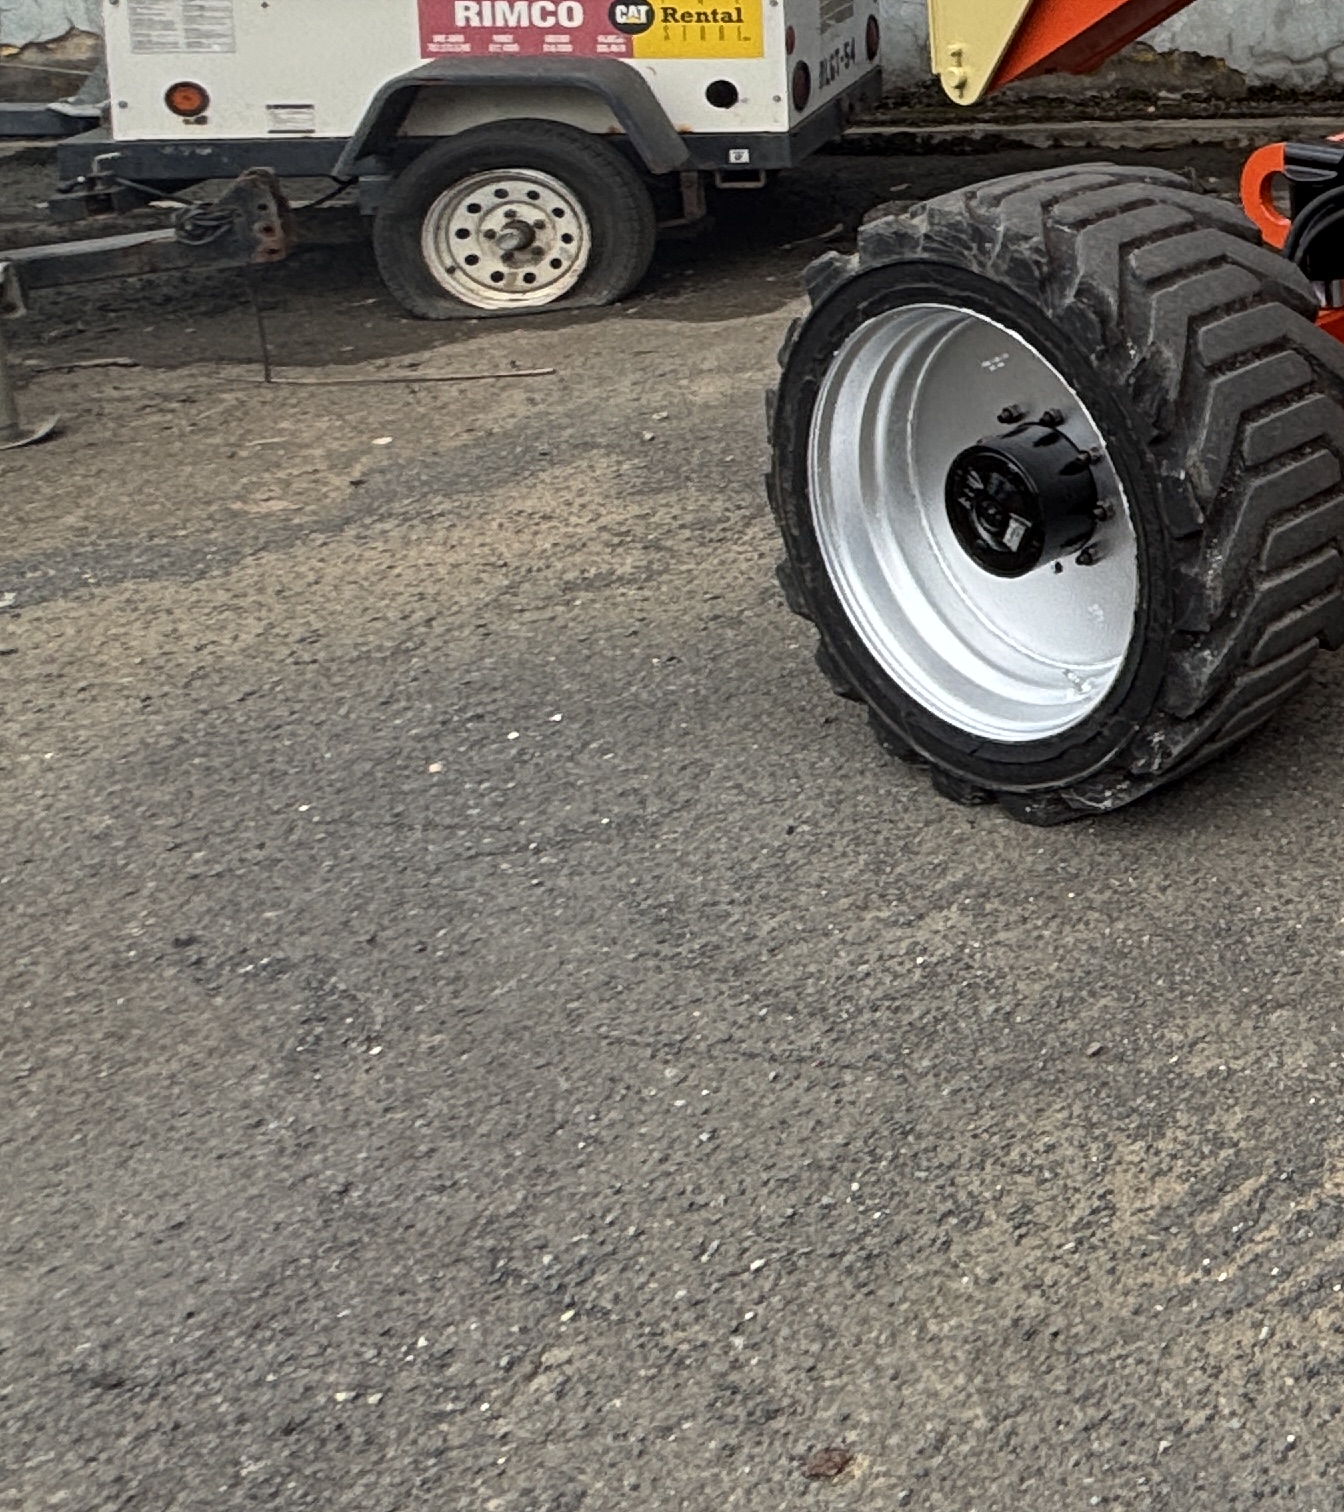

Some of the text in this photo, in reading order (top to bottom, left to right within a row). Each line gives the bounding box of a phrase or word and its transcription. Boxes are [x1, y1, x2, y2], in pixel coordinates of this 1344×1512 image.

[453, 0, 585, 29] RIMCO
[614, 4, 745, 25] CAT Rental
